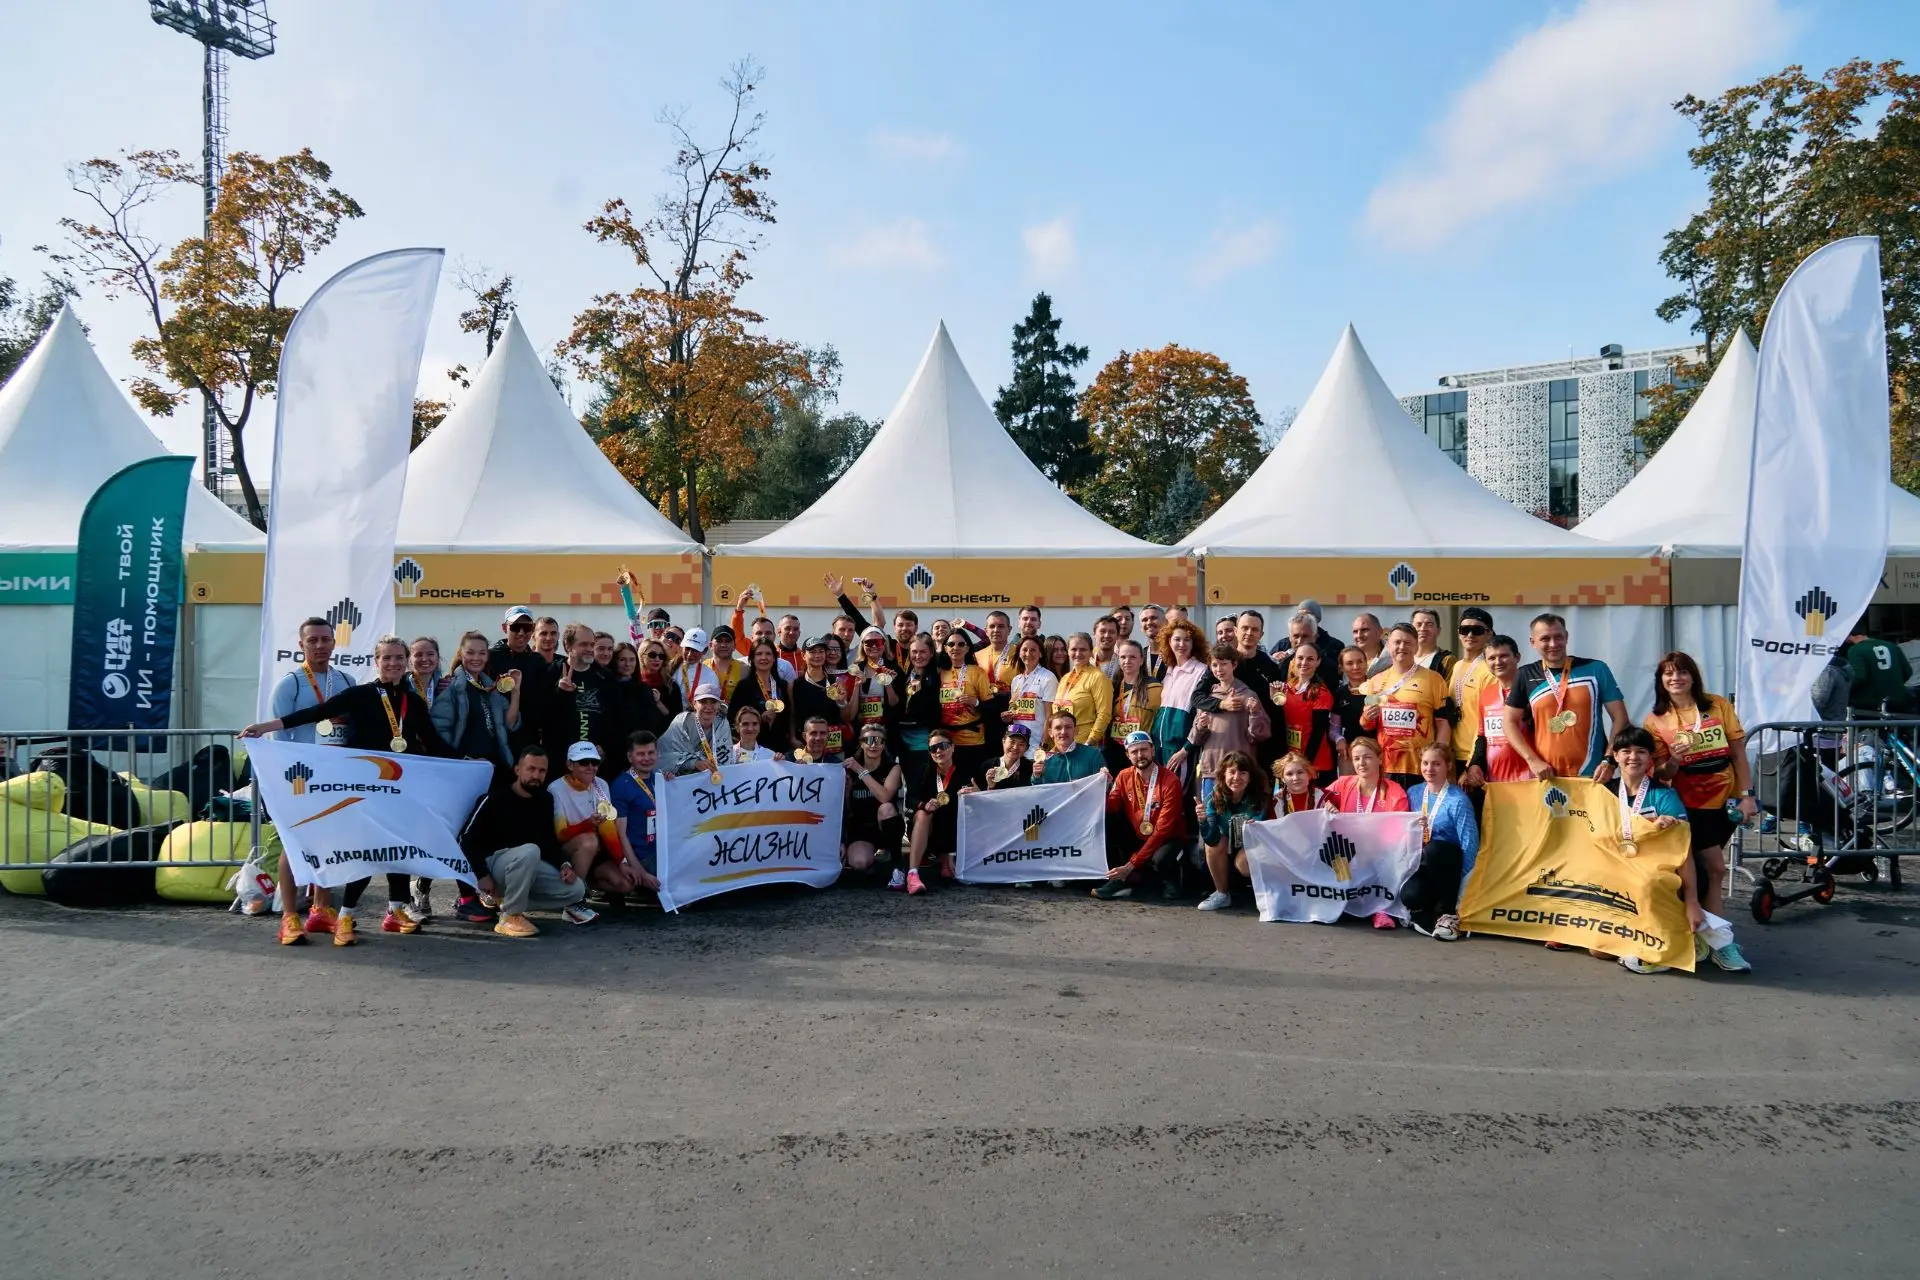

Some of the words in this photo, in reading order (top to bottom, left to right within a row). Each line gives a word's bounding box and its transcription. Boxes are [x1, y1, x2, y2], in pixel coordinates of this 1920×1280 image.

[116, 524, 134, 580] ТВОЙ
[143, 516, 165, 645] ПОМОЩНИК
[197, 587, 206, 597] 3
[419, 589, 505, 599] РОСНЕФТЬ
[720, 590, 729, 600] 2
[930, 594, 1011, 604] РОСНЕФТЬ
[1213, 590, 1219, 599] 1
[1413, 592, 1491, 602] РОСНЕФТЬ
[104, 617, 121, 670] ГИГА
[1872, 645, 1892, 671] 9
[136, 669, 153, 709] ИИ
[1383, 710, 1415, 722] 16849
[309, 783, 401, 795] РОСНЕФТЬ
[692, 775, 825, 814] ЭНЕРГИЯ
[709, 830, 812, 867] ЖИЗНИ
[983, 846, 1082, 866] РОСНЕФТЬ
[1291, 884, 1395, 901] РОСНЕФТЬ
[1491, 908, 1666, 951] РОСНЕФТЕФЛОТ
